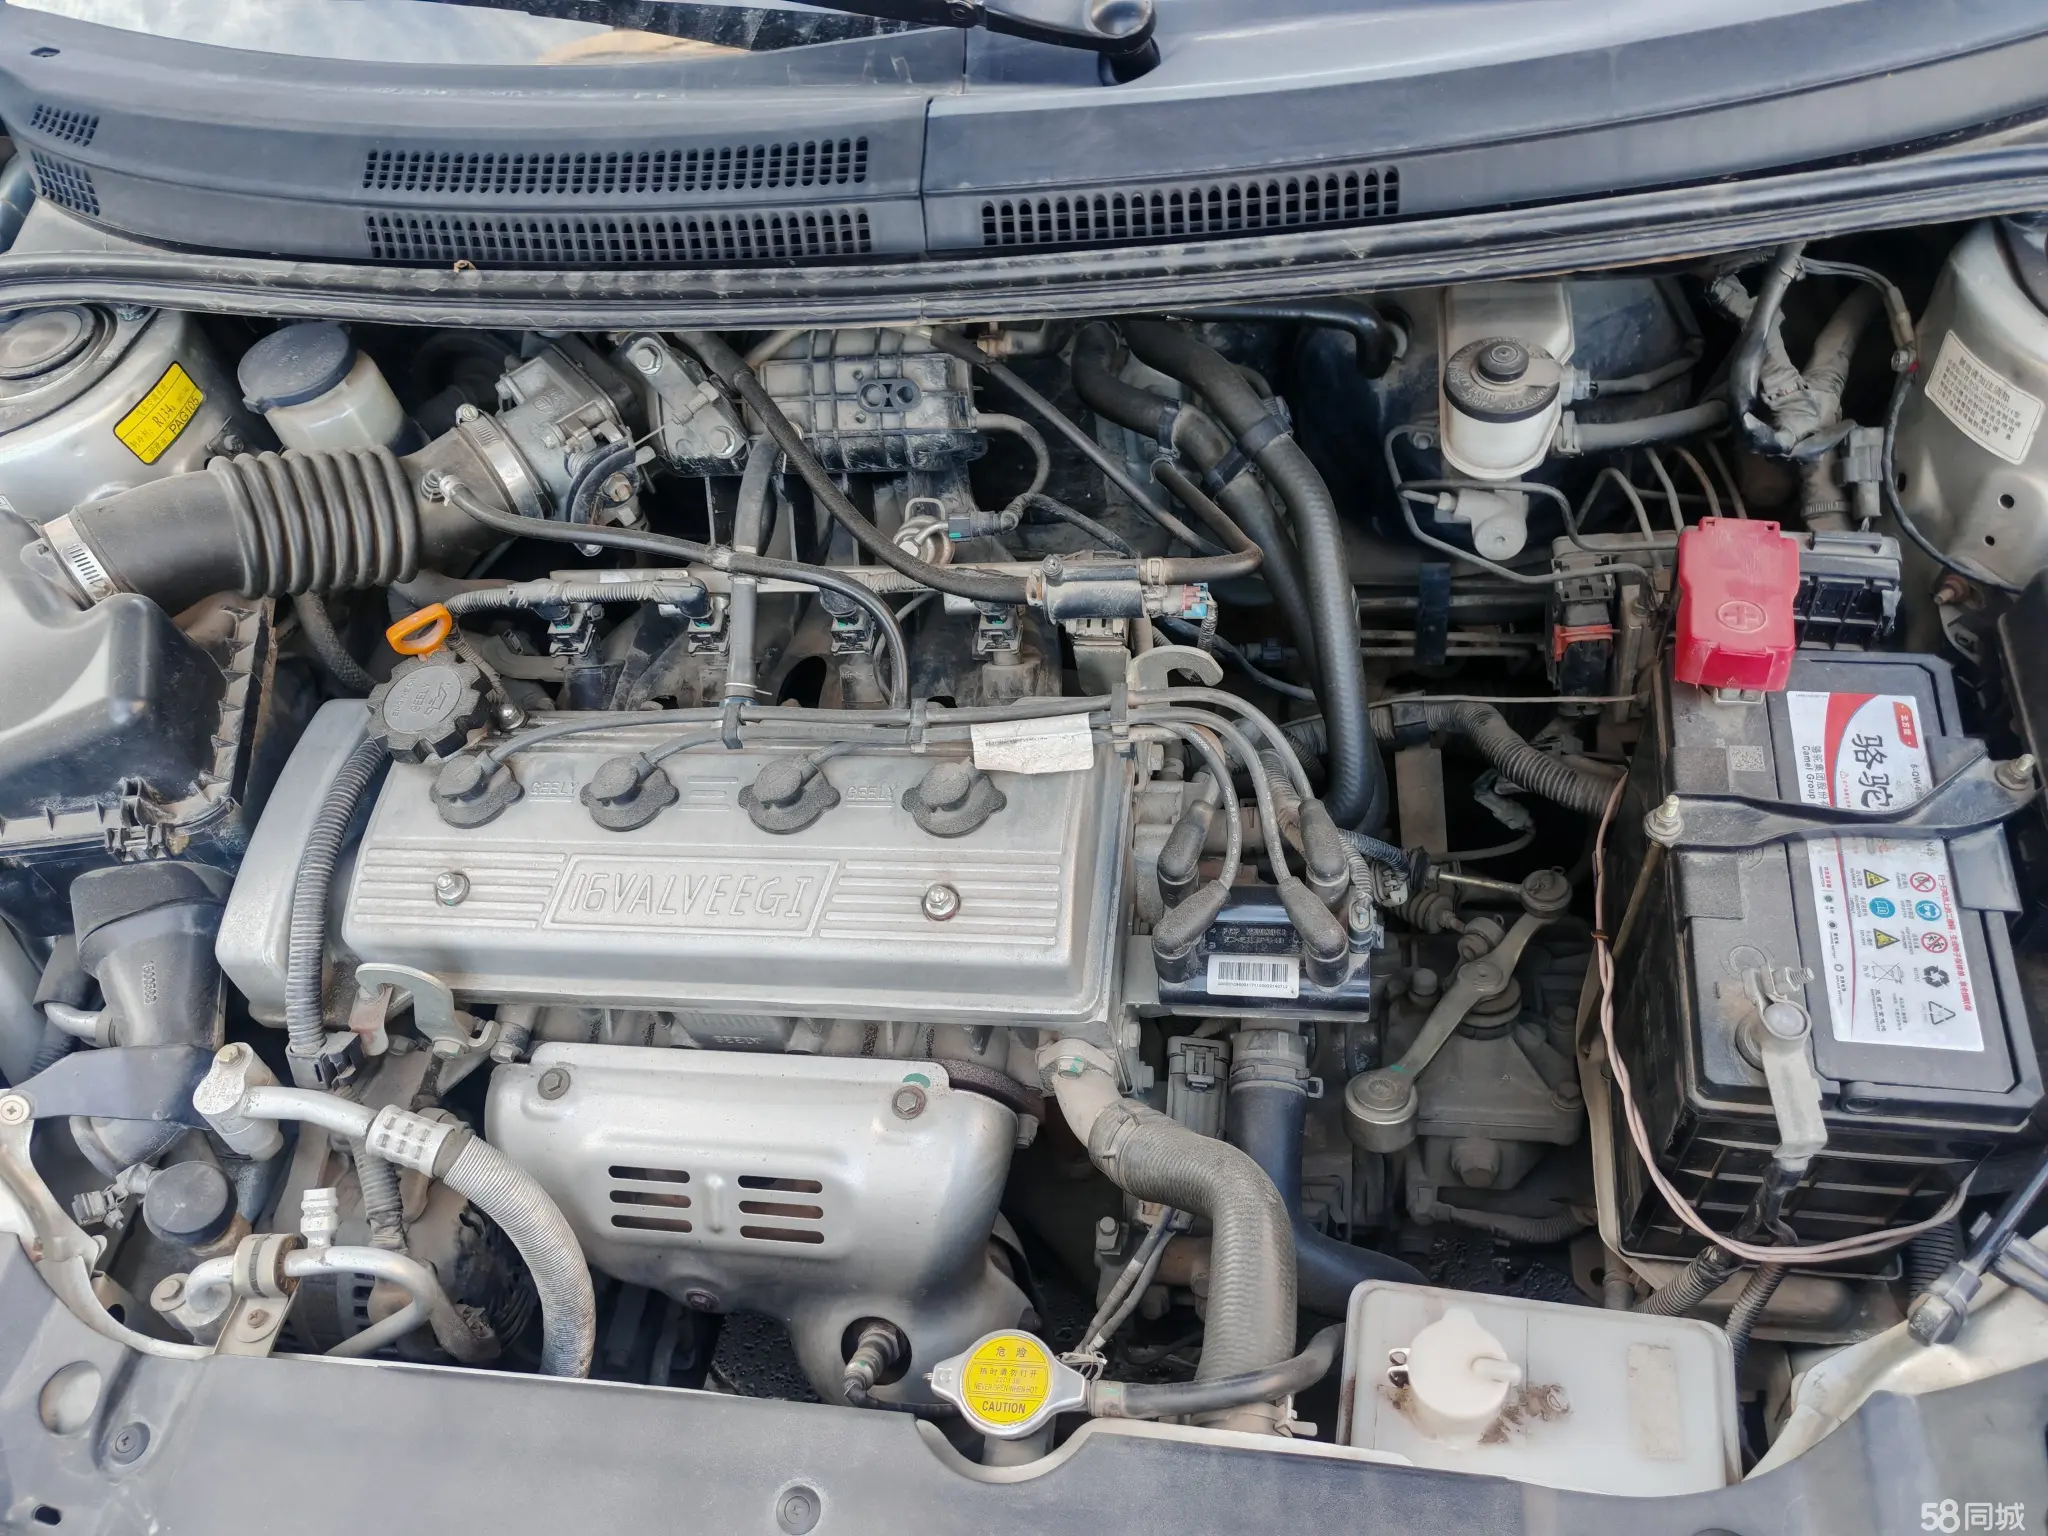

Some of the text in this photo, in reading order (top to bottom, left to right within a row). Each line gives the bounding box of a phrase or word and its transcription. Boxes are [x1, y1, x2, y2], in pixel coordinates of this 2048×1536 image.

[168, 395, 200, 435] PAG105
[1802, 745, 1816, 800] Camel Group
[1852, 733, 1894, 809] 骆驼
[981, 1400, 1026, 1414] CAUTION
